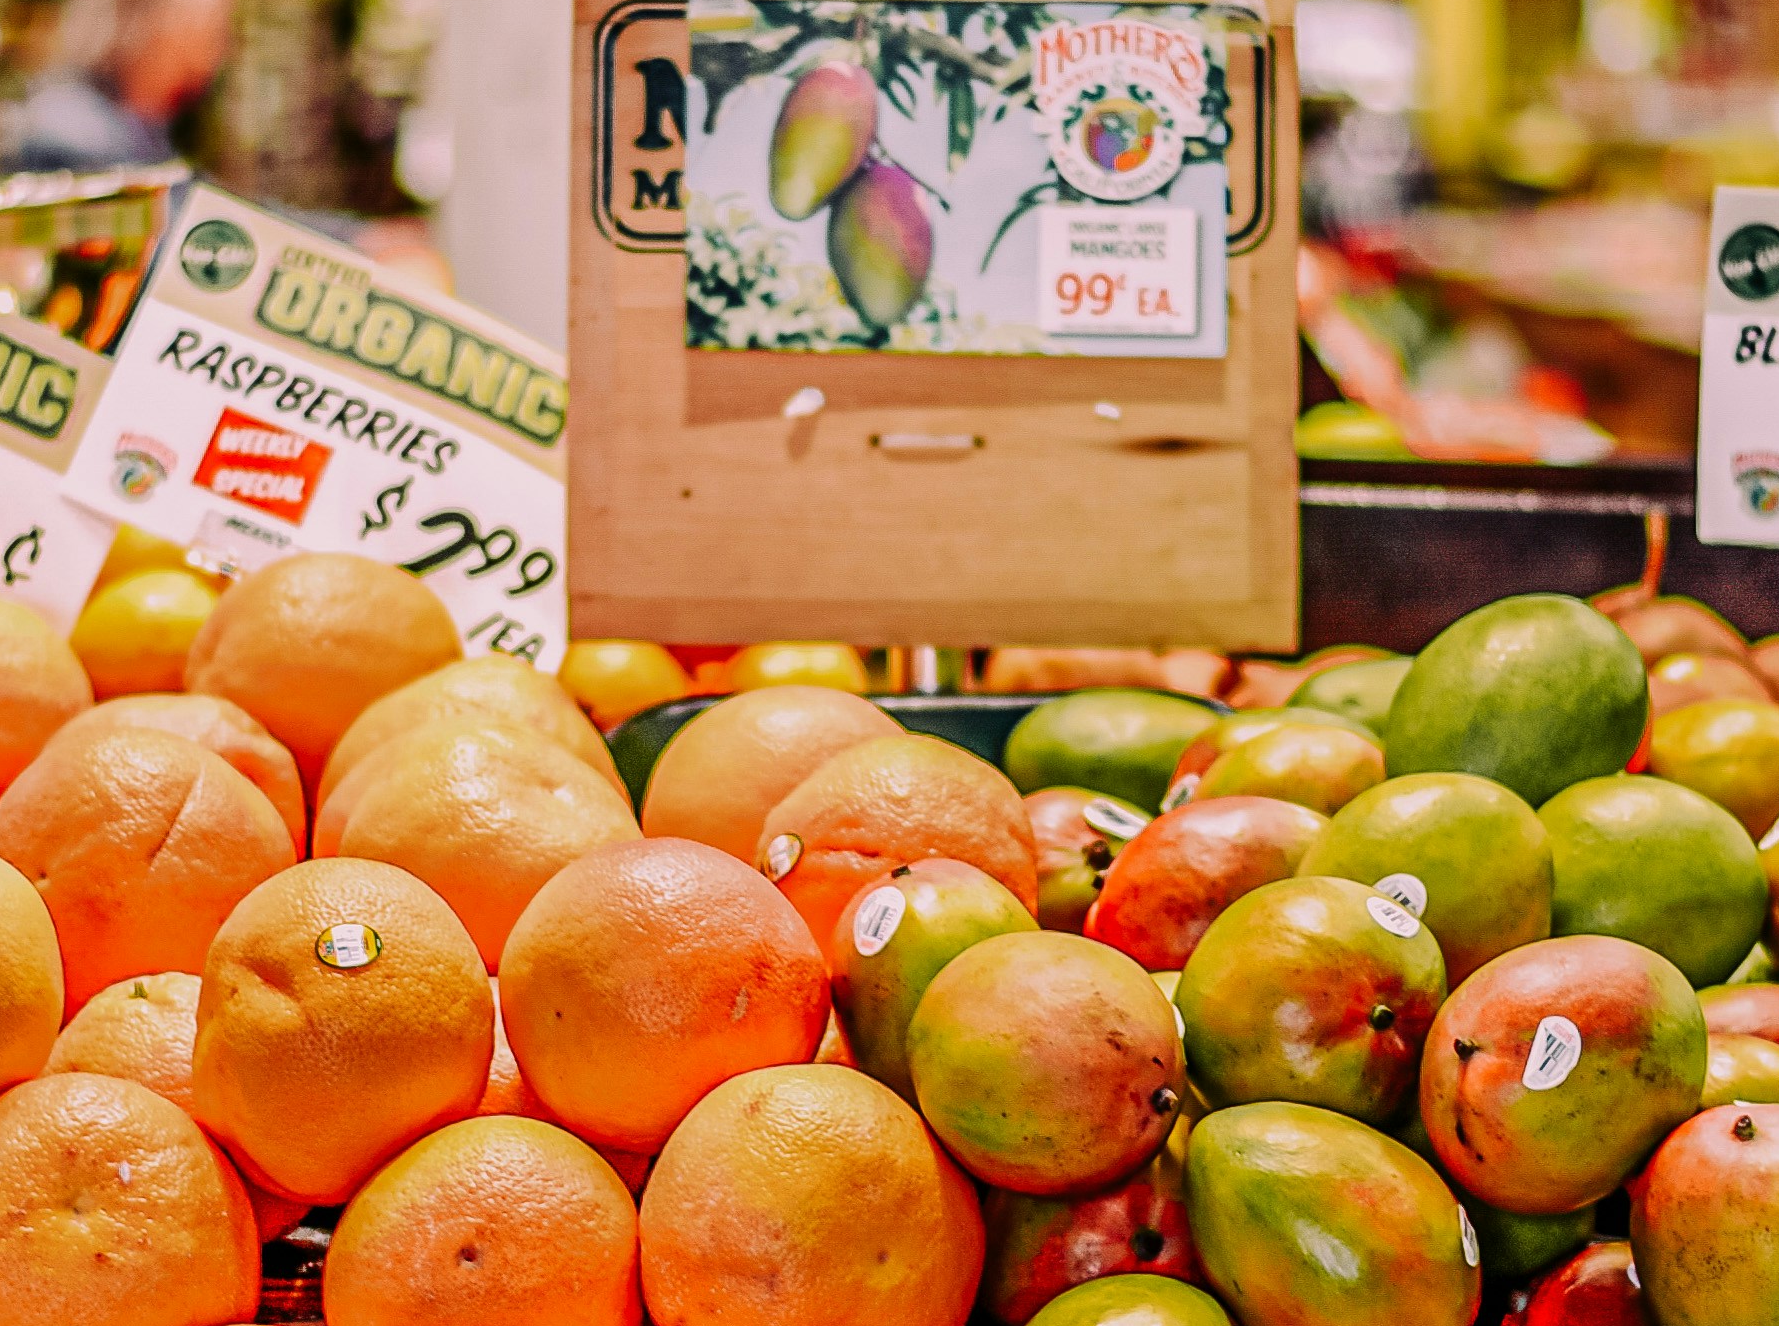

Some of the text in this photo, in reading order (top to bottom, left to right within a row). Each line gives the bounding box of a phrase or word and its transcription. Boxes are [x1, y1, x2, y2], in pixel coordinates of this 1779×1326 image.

[1070, 240, 1166, 259] MANGOES
[266, 275, 568, 436] ORGANIC
[159, 329, 462, 475] RASPBERRIES
[216, 425, 310, 461] WEEKLY
[211, 469, 307, 508] SPECIAL
